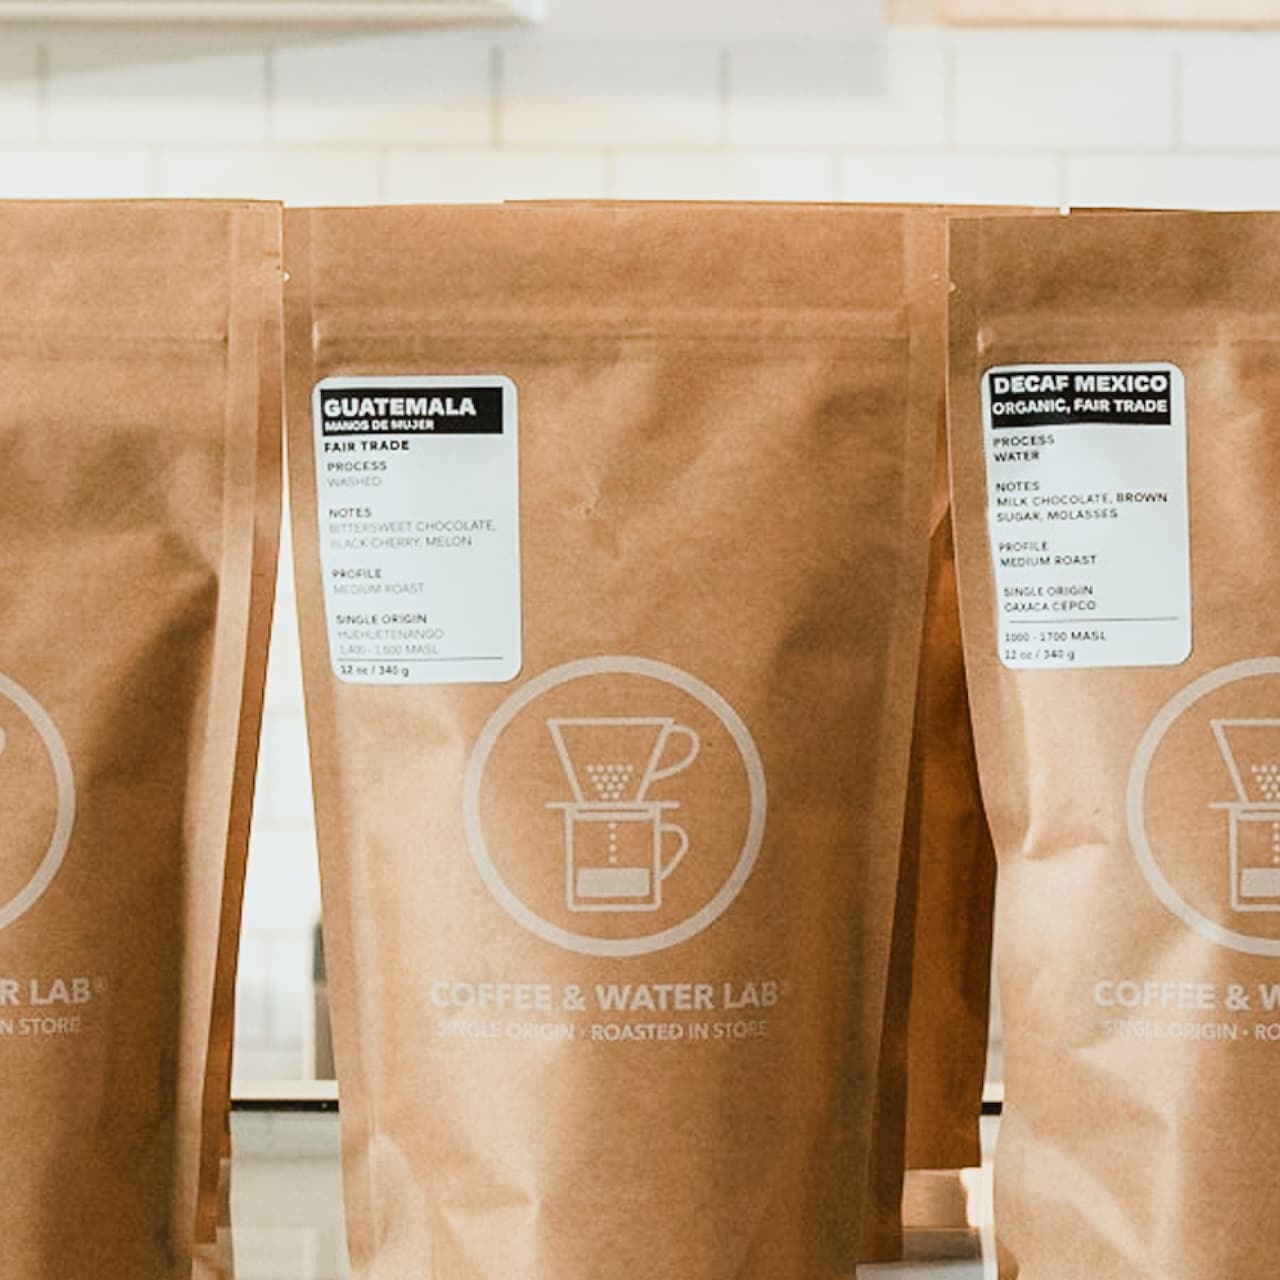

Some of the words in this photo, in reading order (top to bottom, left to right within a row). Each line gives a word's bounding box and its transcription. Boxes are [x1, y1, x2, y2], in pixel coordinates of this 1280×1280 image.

[994, 375, 1069, 394] DECAF
[1075, 374, 1168, 393] MEXICO
[324, 397, 477, 417] GUATEMALA
[992, 399, 1071, 415] ORGANIC,
[1074, 399, 1110, 413] FAIR
[1113, 399, 1168, 413] TRADE
[370, 420, 388, 431] DE
[324, 442, 356, 453] FAIR
[361, 440, 410, 451] TRADE
[994, 435, 1055, 447] PROCESS
[994, 451, 1039, 462] WATER
[327, 461, 387, 471] PROCESS
[996, 481, 1039, 492] NOTES
[1116, 492, 1168, 503] BROWN
[328, 507, 372, 518] NOTES
[431, 981, 551, 1010] COFFEE
[562, 984, 586, 1011] &
[596, 984, 715, 1011] WATER
[1092, 981, 1215, 1009] COFFEE
[1225, 984, 1251, 1011] &
[19, 1016, 81, 1035] STORE
[591, 1022, 684, 1041] ROASTED
[688, 1022, 709, 1040] IN
[713, 1021, 768, 1039] STORE
